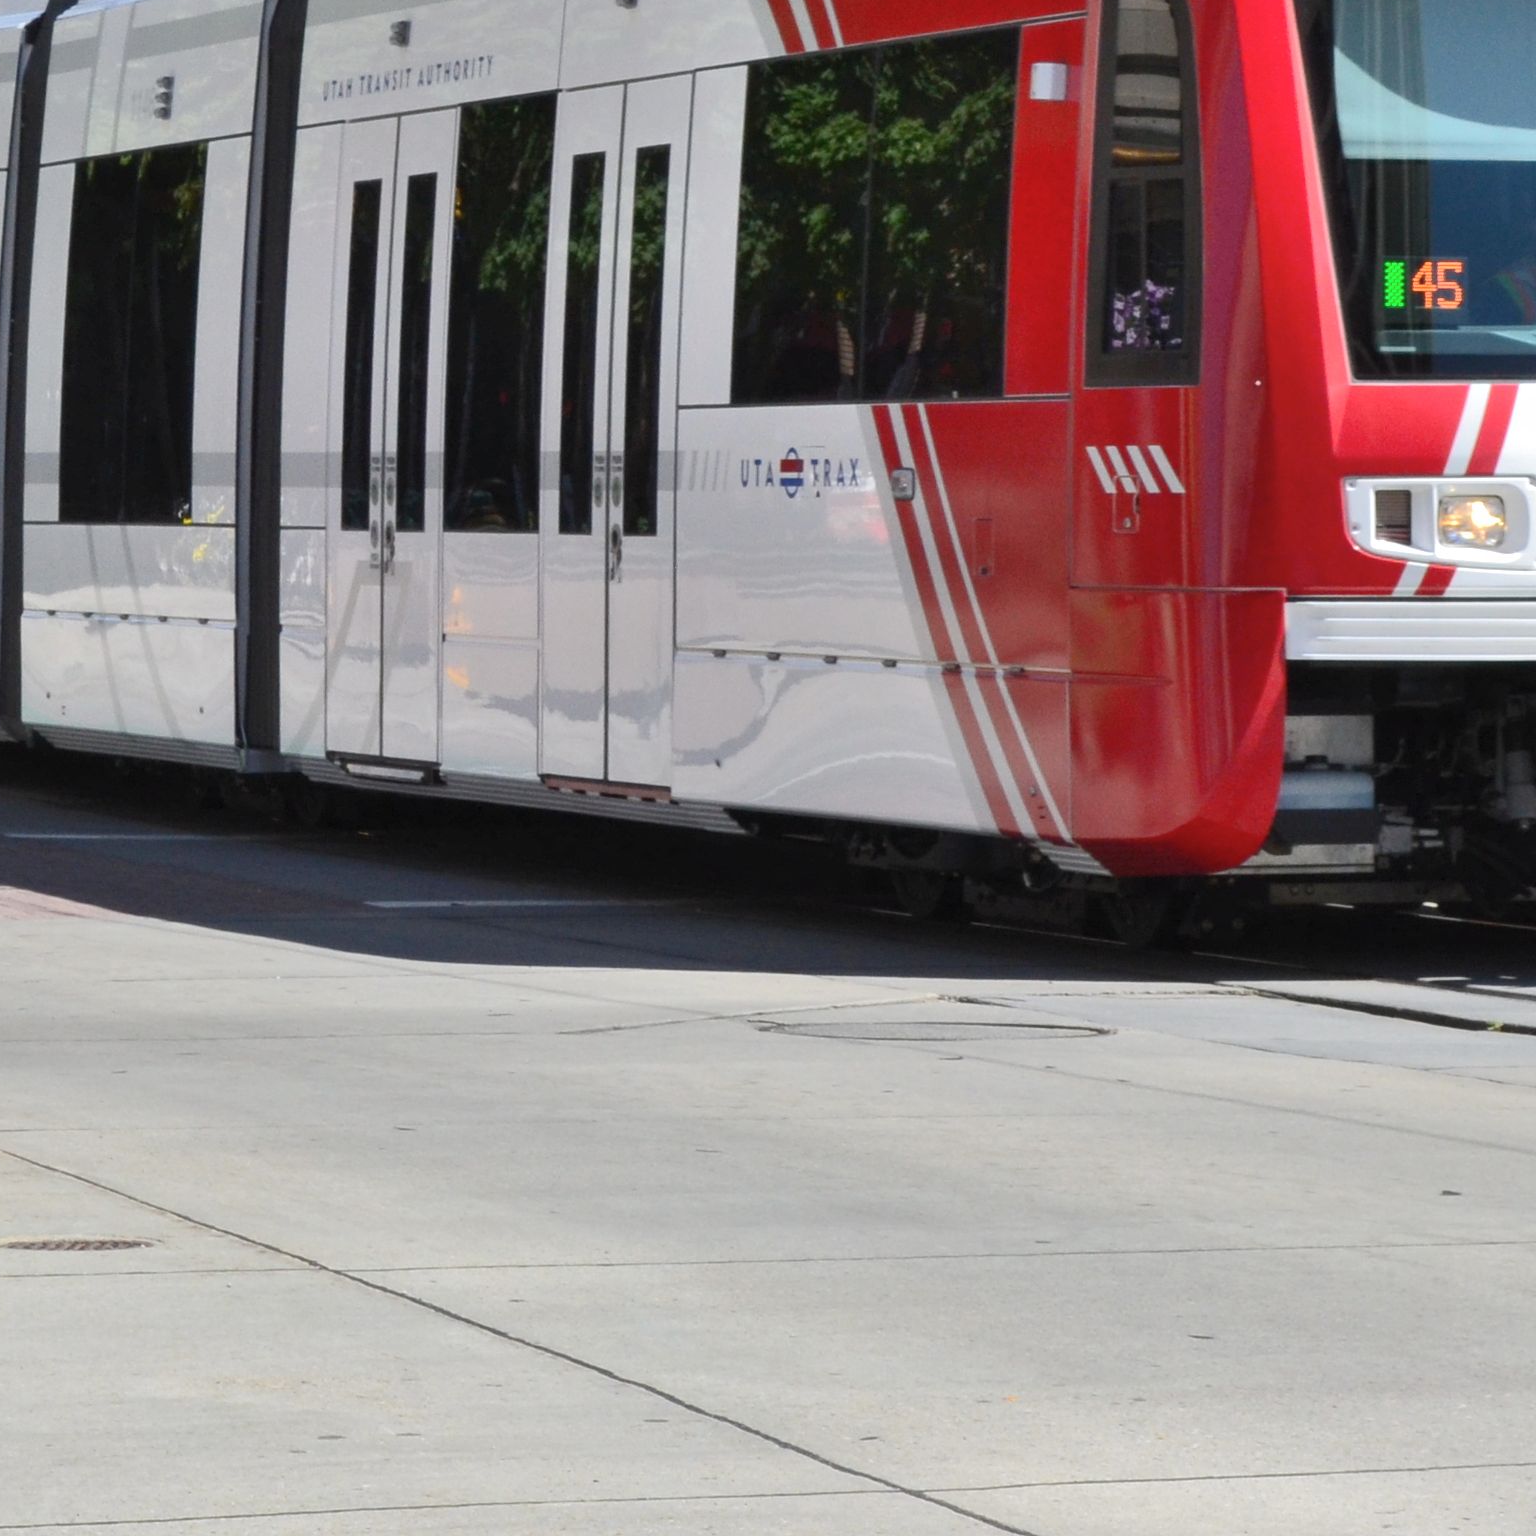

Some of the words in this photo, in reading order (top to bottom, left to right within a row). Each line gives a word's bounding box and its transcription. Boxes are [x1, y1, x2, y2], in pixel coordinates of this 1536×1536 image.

[322, 77, 353, 101] UTAH
[360, 68, 412, 95] TRANSIT
[417, 55, 494, 87] AUTHORITY
[1412, 261, 1463, 309] 45
[740, 459, 775, 488] UTA
[810, 458, 859, 487] TRAX
